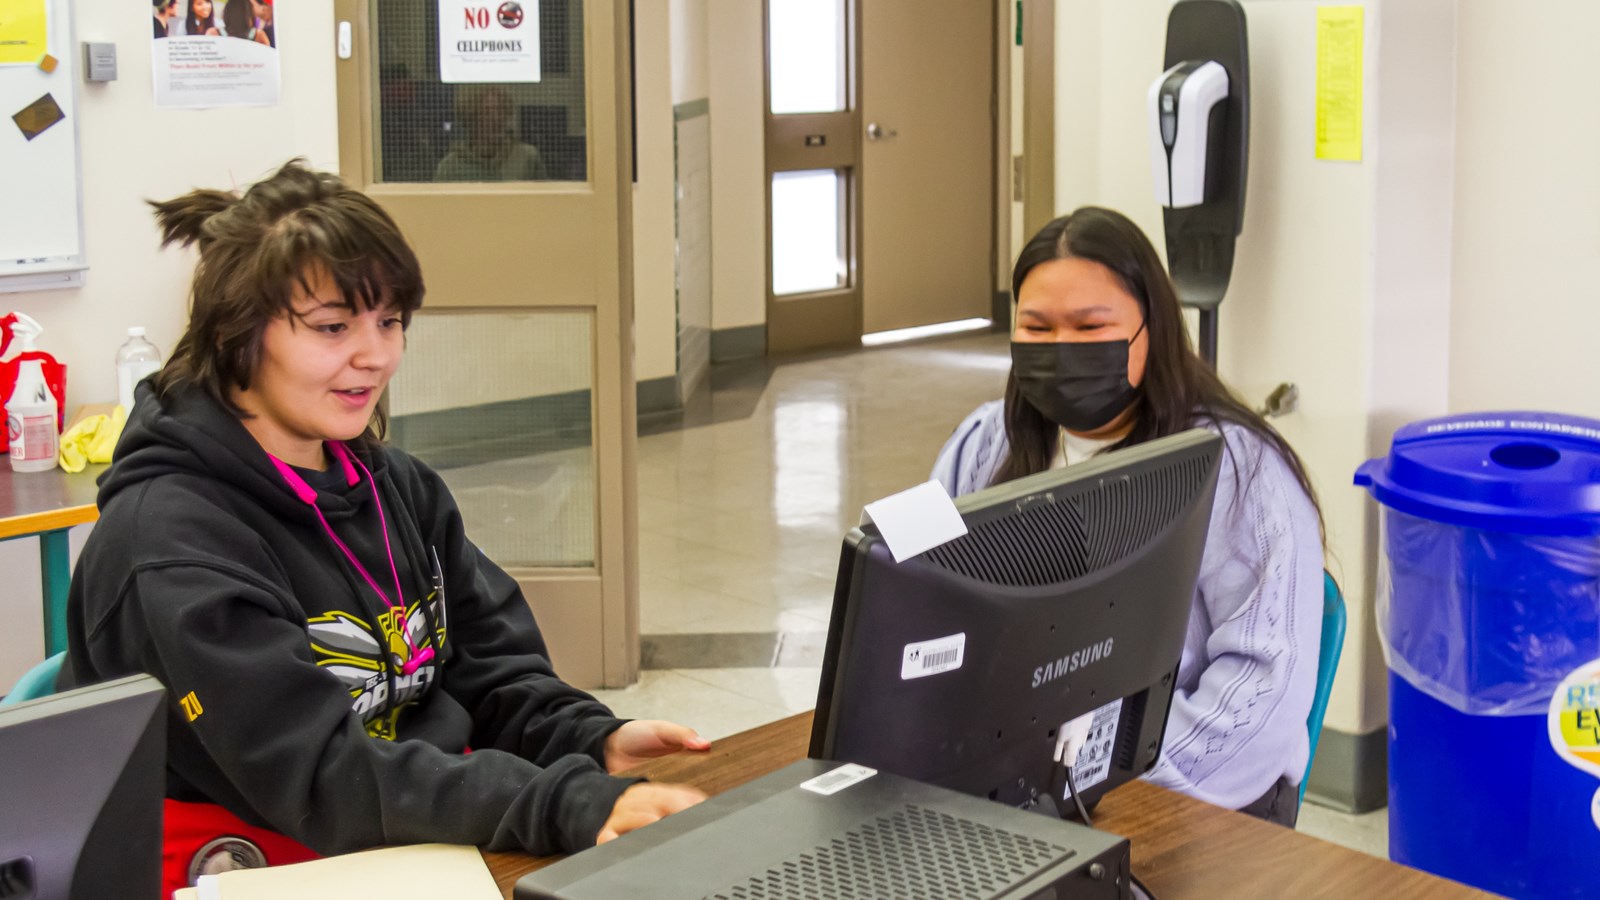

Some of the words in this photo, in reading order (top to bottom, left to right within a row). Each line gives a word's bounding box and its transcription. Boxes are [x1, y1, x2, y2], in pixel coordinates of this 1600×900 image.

[464, 7, 490, 29] NO
[457, 40, 522, 52] CELLPHONES
[1427, 420, 1505, 433] BEVERAGE
[1032, 637, 1114, 688] SAMSUNG
